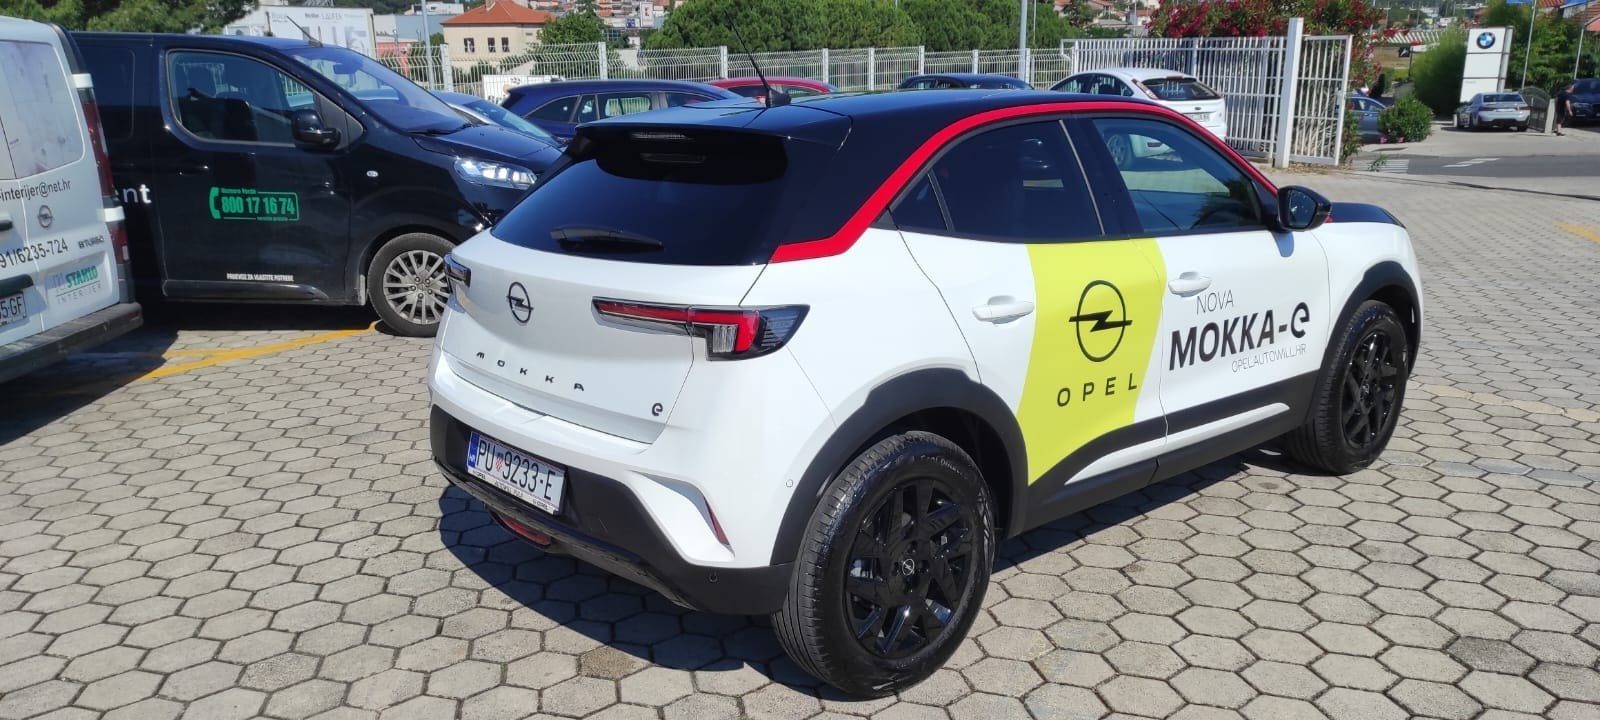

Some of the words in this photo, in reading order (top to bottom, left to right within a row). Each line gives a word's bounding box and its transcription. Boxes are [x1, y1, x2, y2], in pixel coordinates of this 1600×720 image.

[115, 183, 152, 205] nt
[221, 196, 244, 213] 800
[246, 197, 260, 214] 17
[262, 197, 277, 215] 16
[278, 197, 295, 215] 74
[1196, 289, 1235, 315] NOVA
[1169, 301, 1310, 371] MOKKA-e
[476, 351, 585, 392] MOKKA
[1056, 373, 1138, 407] OPEL
[477, 440, 496, 471] PU
[502, 451, 556, 501] 9233-E
